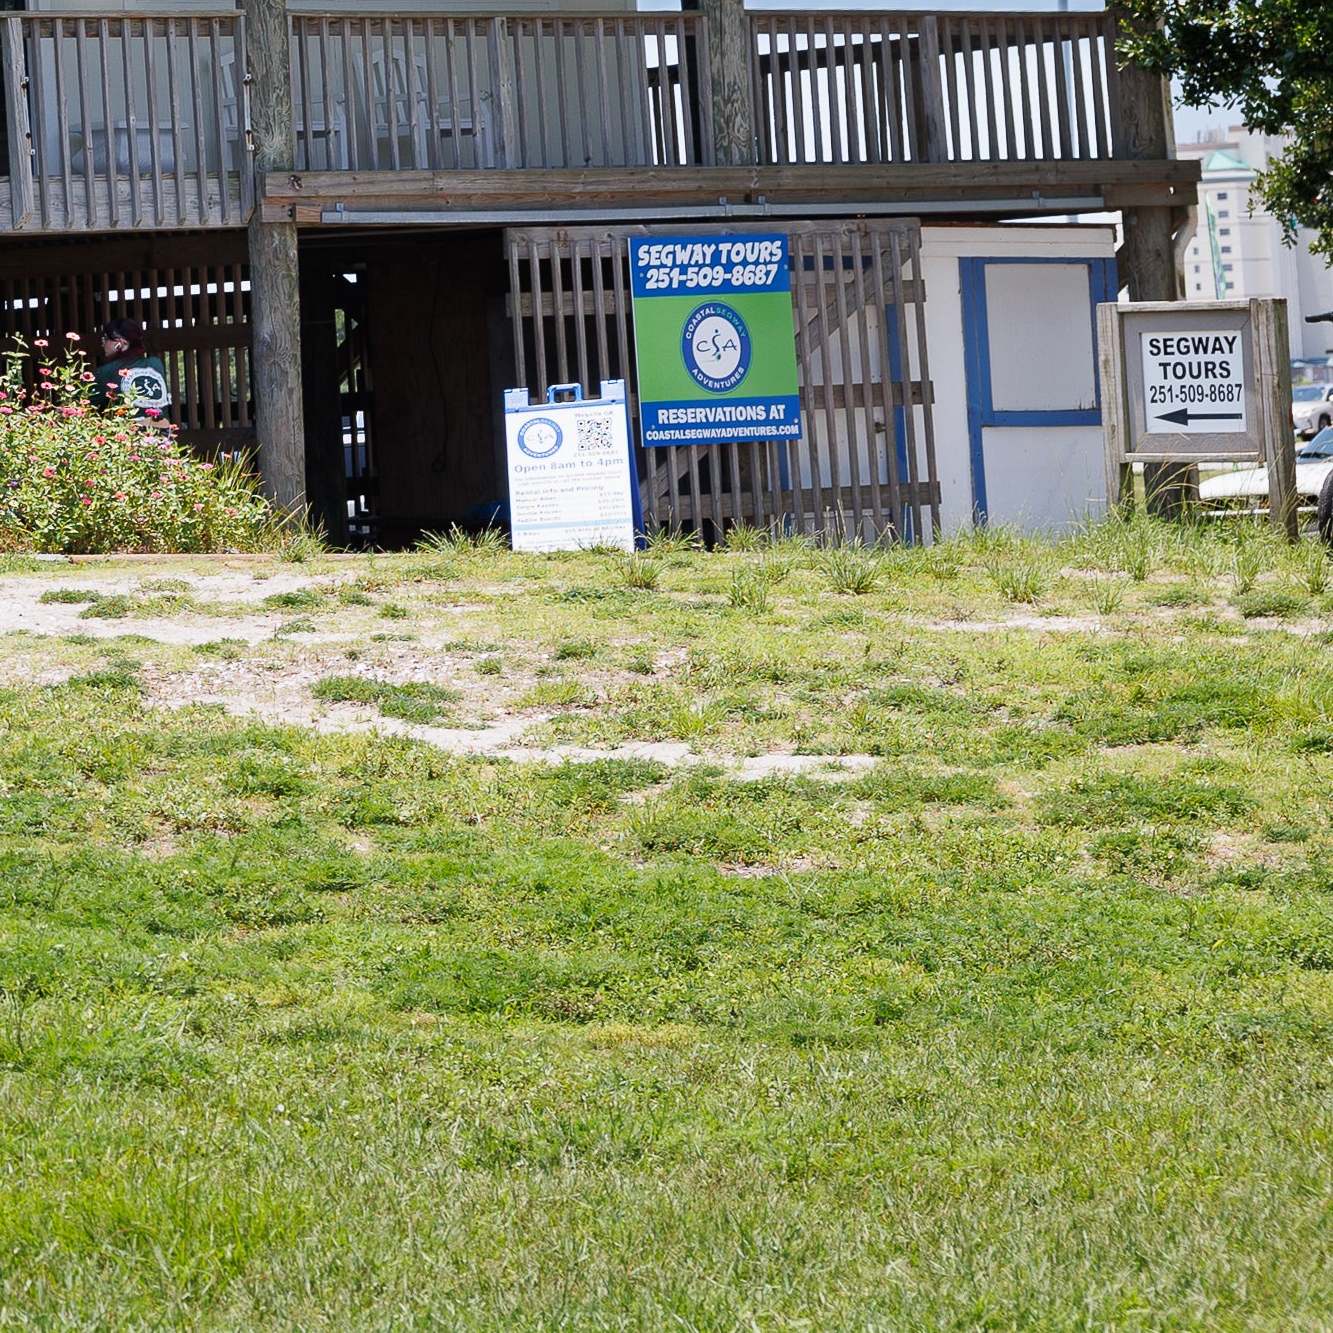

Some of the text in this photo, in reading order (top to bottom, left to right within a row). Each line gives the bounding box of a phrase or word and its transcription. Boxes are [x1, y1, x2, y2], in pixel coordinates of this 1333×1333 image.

[638, 240, 783, 267] SEGWAY TOURS
[645, 264, 779, 290] 251-509-8687
[685, 307, 746, 340] COASTAL SEGWAY
[1149, 335, 1238, 357] SEGWAY
[692, 366, 745, 389] ADVENTURES
[1158, 360, 1231, 380] TOURS
[1149, 383, 1243, 404] 251-509-8687
[658, 404, 786, 425] RESERVATIONS AT
[646, 424, 799, 441] COASTALSEGWAYADVENTURES.COM
[514, 458, 624, 474] Open 8am to 4pm
